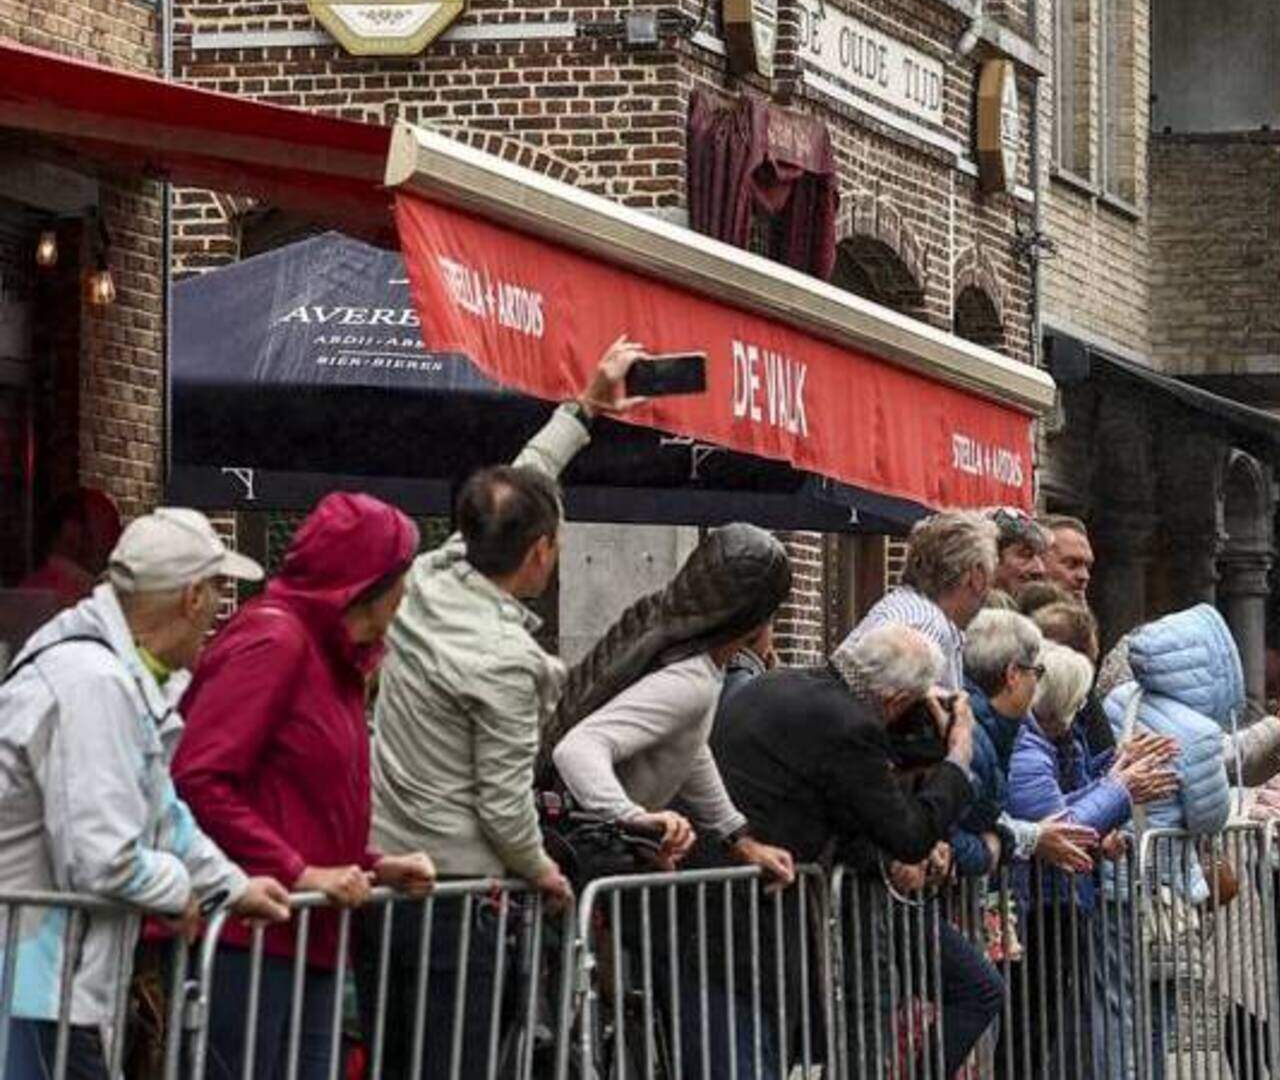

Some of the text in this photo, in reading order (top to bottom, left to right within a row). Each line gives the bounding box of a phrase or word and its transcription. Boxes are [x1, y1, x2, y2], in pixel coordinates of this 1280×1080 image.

[797, 4, 940, 111] DE OUDE TIJD
[281, 305, 421, 327] AVERB
[498, 280, 545, 339] ARTOIS
[732, 339, 809, 438] DE VALK
